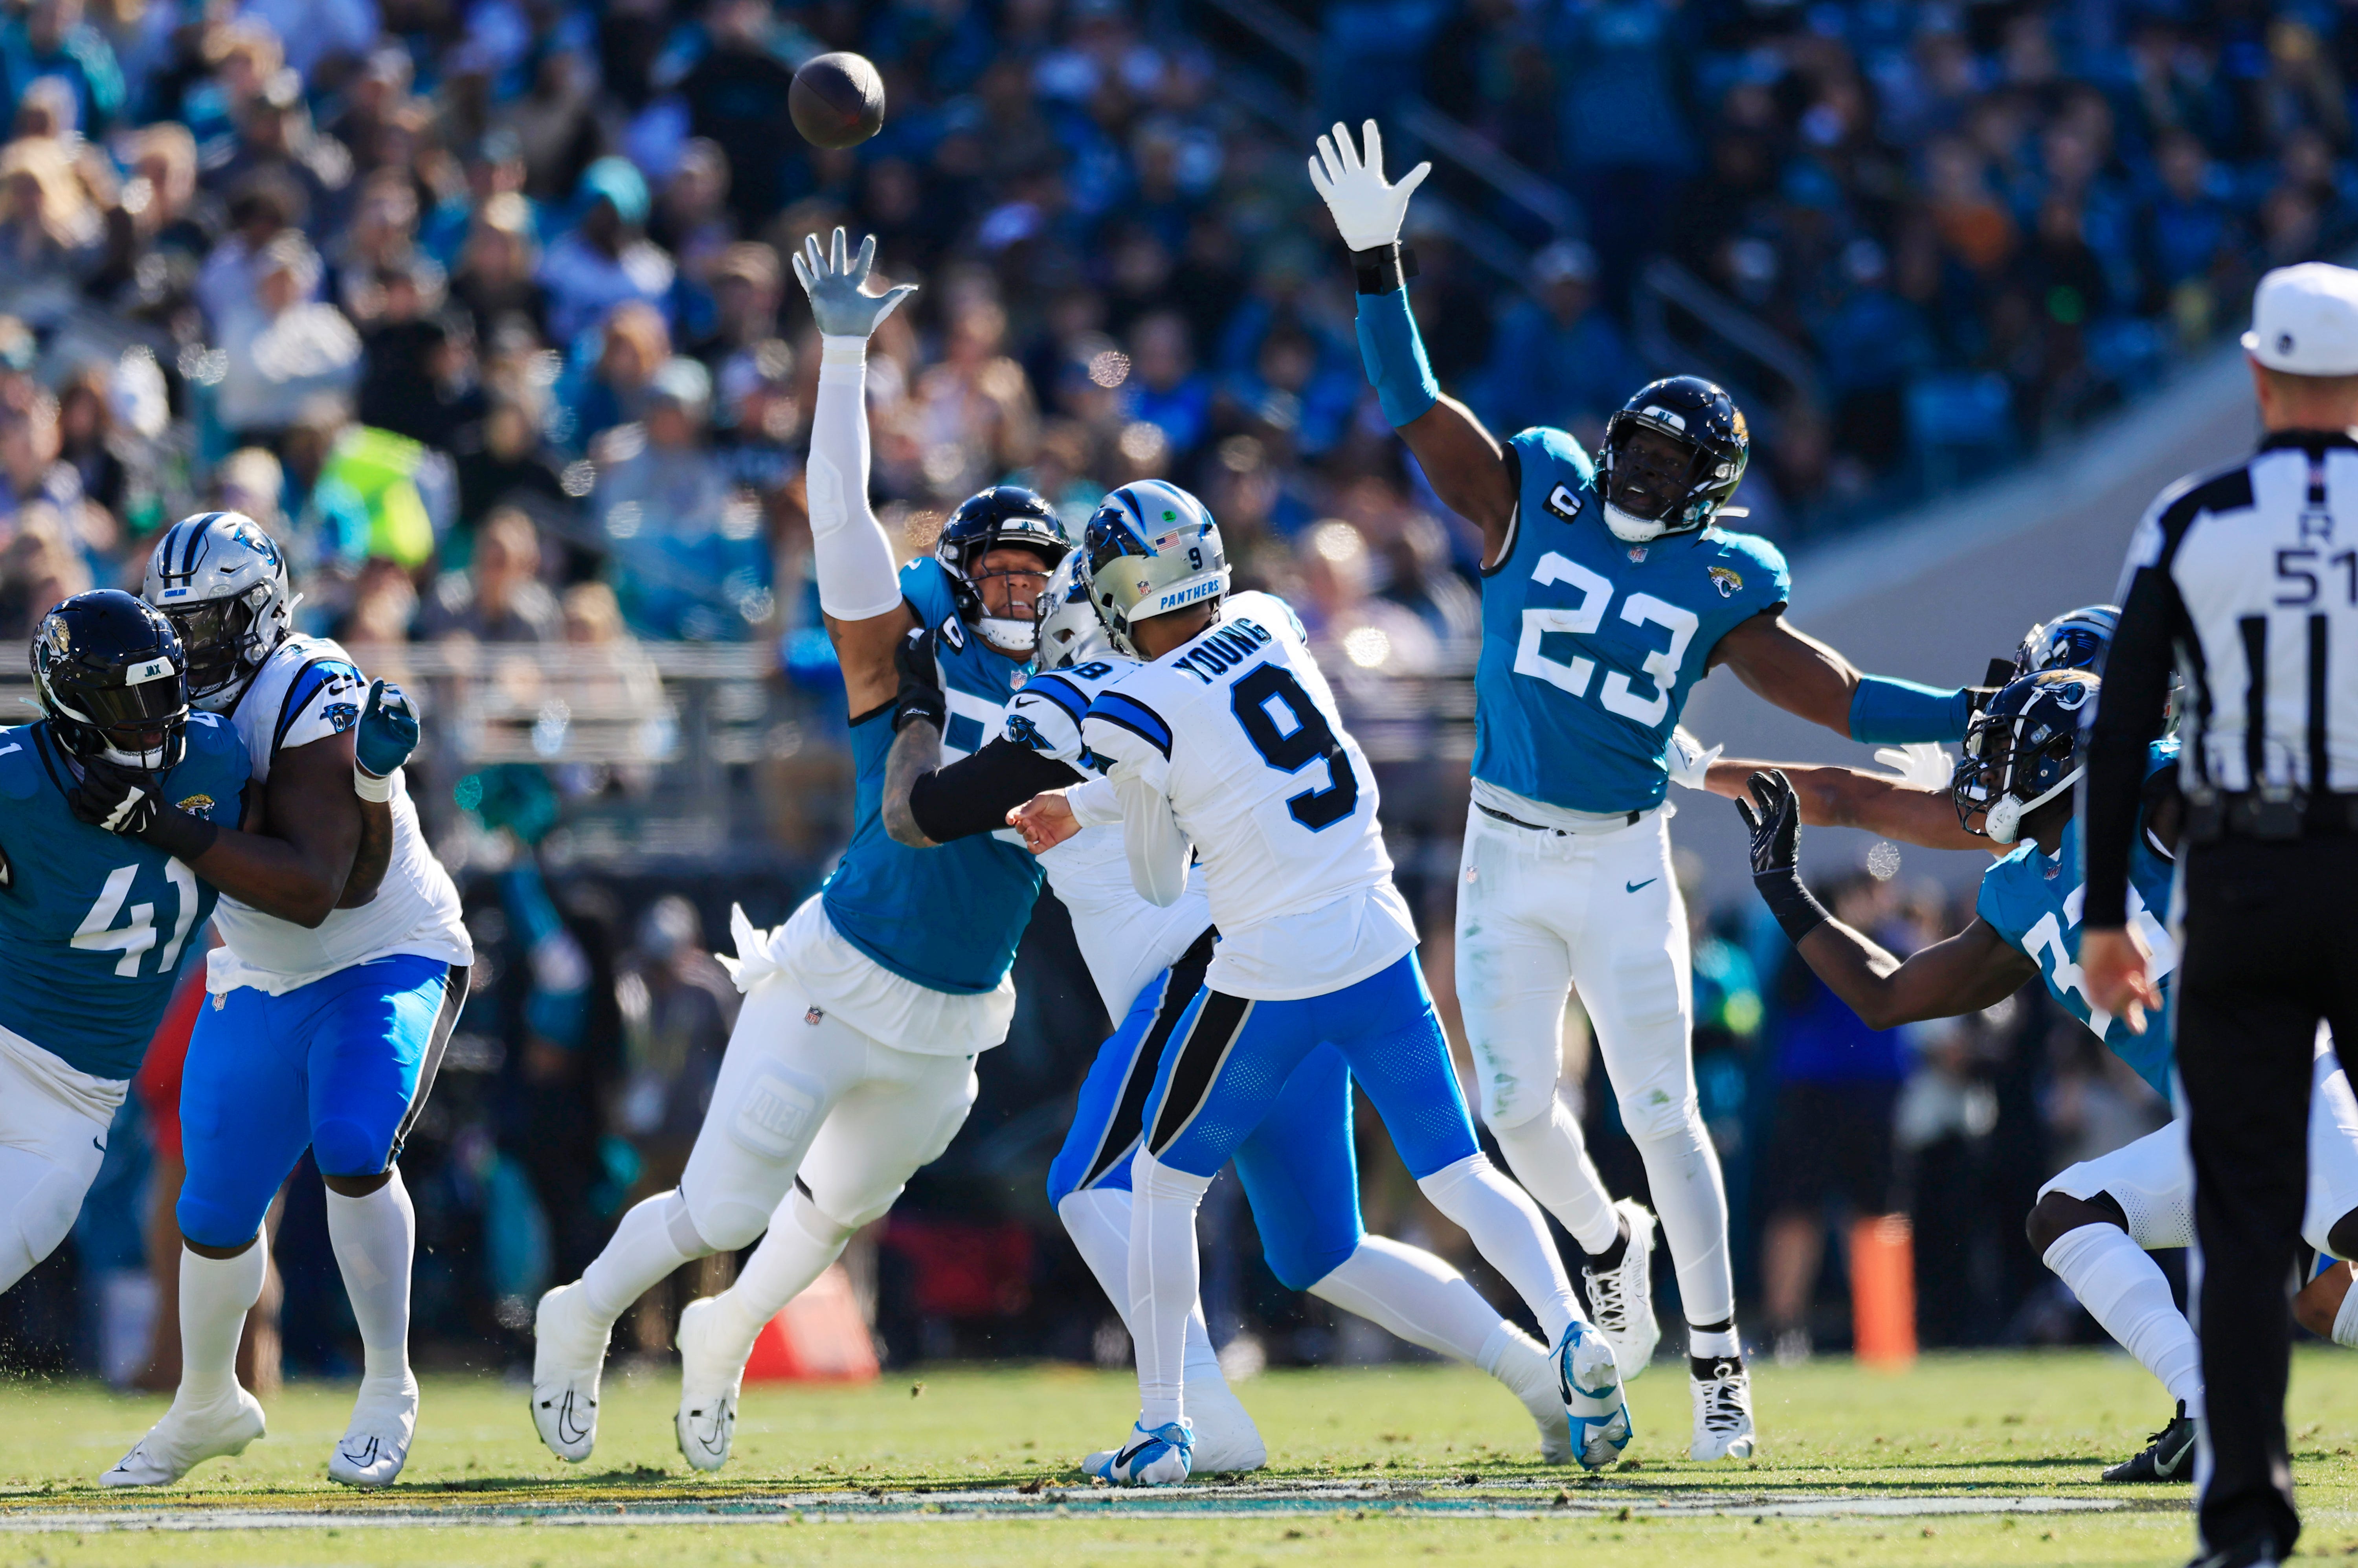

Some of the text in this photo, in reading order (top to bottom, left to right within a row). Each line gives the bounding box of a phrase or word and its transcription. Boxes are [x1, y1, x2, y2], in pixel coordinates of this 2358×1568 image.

[1653, 411, 1673, 424] AX
[1550, 486, 1581, 516] C
[2300, 514, 2333, 546] R
[1188, 547, 1203, 570] 9
[2277, 550, 2357, 606] 51
[1160, 580, 1219, 610] PANTHERS
[1171, 618, 1272, 685] YOUNG
[1513, 551, 1699, 728] 23
[145, 664, 161, 677] JAX
[1230, 661, 1359, 833] 9
[70, 856, 198, 978] 41
[741, 1088, 809, 1140] JALEN
